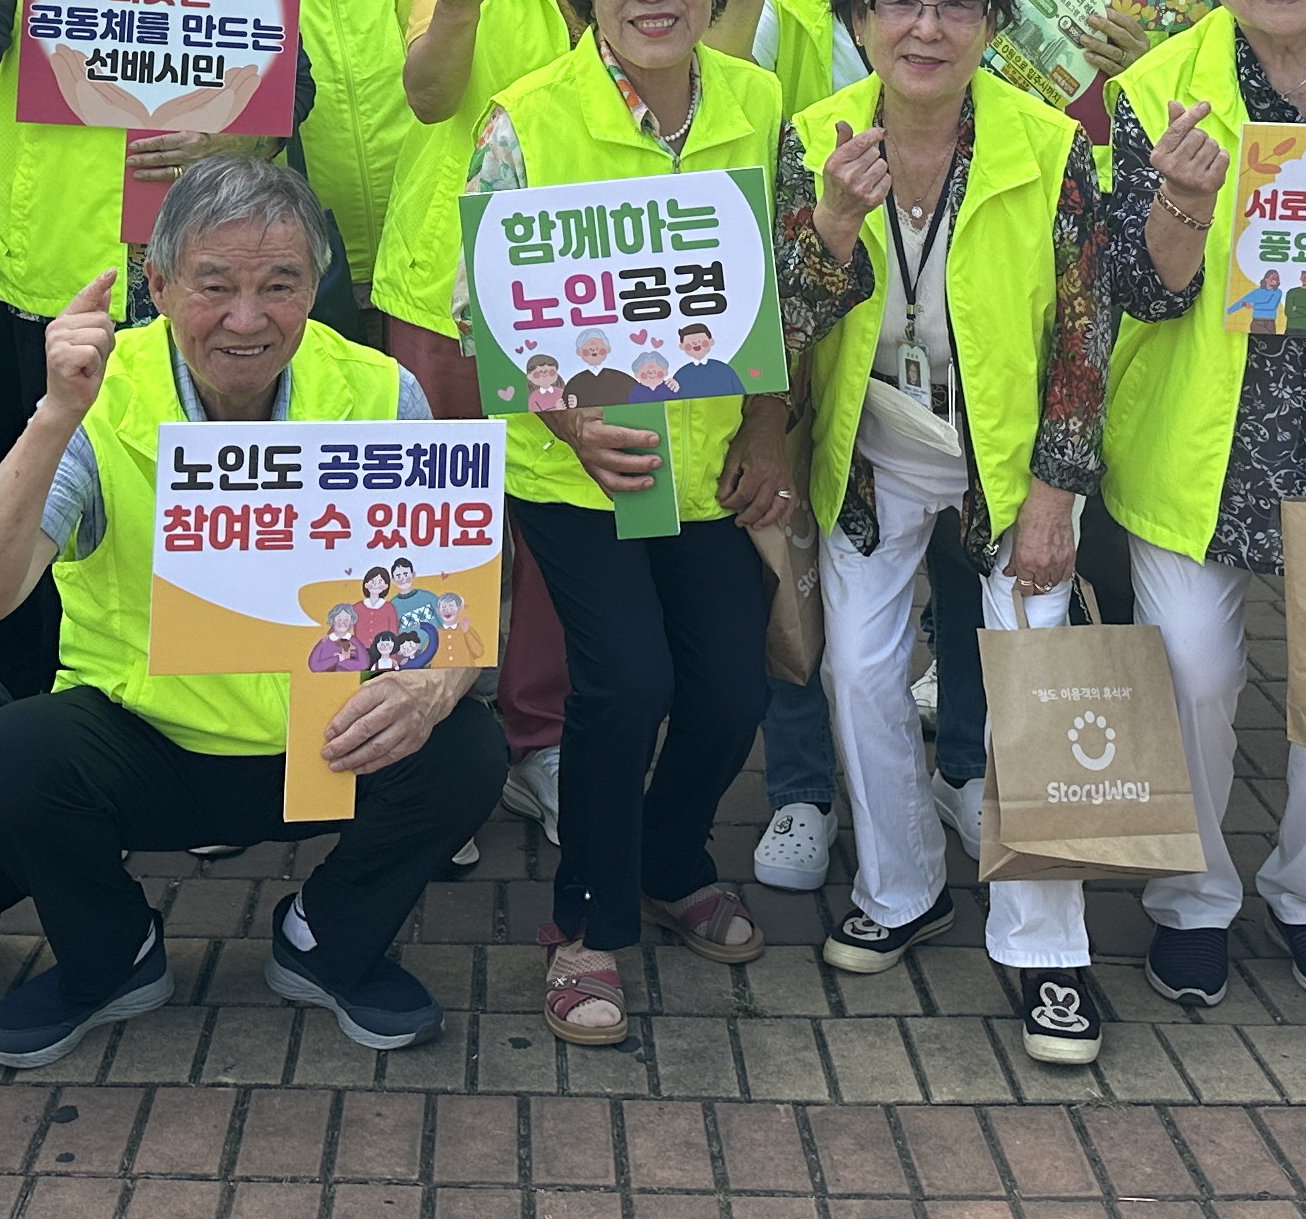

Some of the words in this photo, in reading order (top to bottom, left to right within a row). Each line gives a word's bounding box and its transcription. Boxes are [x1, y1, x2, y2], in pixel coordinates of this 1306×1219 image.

[28, 4, 170, 46] 공동체를
[182, 14, 285, 52] 만드는
[85, 48, 225, 89] 선배시민
[500, 198, 720, 267] 함께하는
[511, 260, 728, 331] 노인공경
[170, 444, 304, 492] 노인도
[317, 442, 491, 491] 공동체에
[162, 503, 299, 553] 참여할
[309, 503, 352, 550] 수
[366, 502, 494, 550] 있어요
[1060, 686, 1101, 701] 이용객의
[1047, 780, 1151, 805] StoryWay
